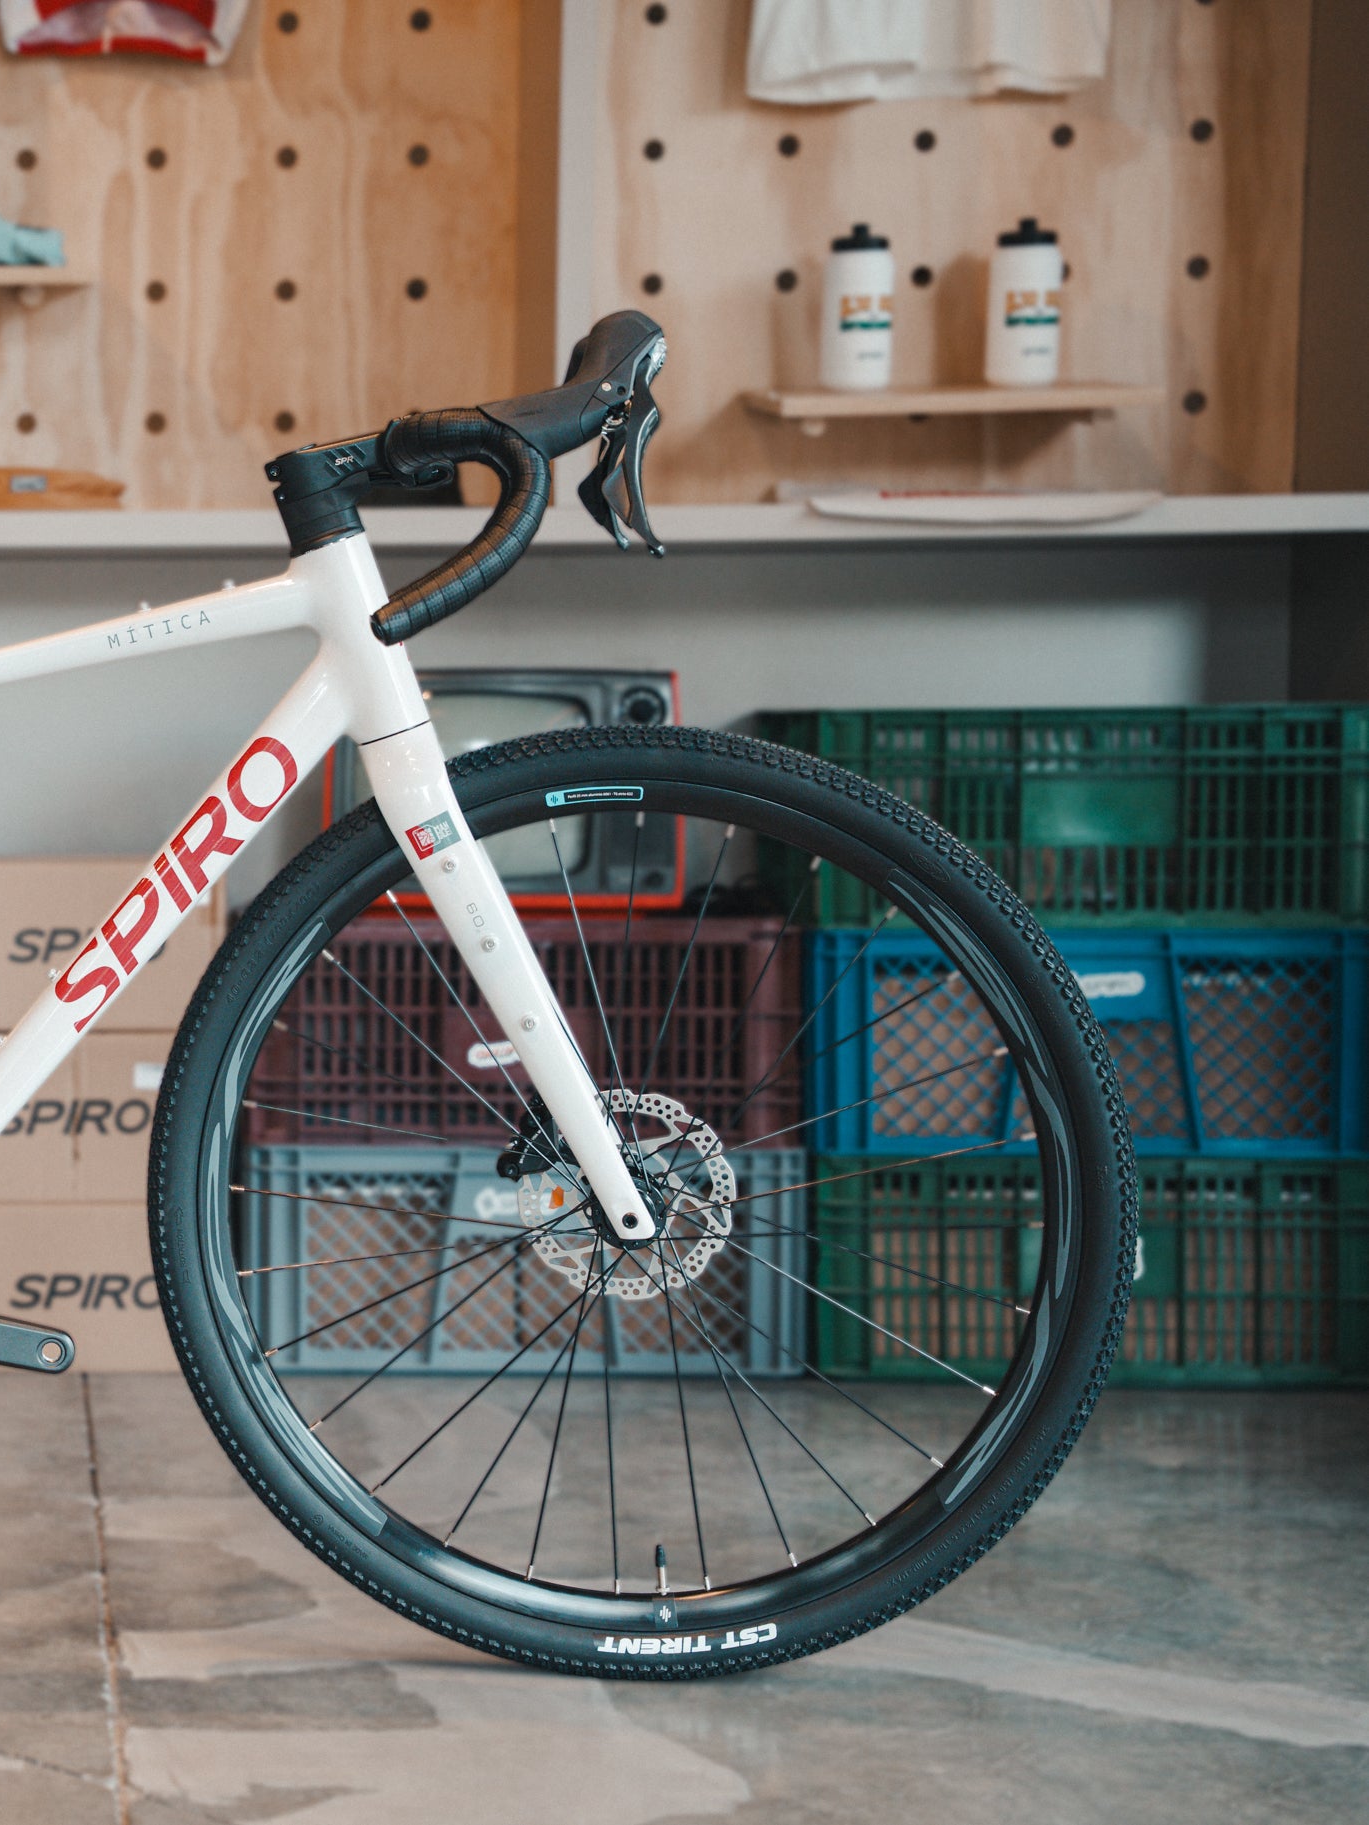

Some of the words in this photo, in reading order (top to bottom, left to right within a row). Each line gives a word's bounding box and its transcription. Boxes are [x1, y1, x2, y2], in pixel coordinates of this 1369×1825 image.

[335, 455, 354, 466] SPR
[107, 610, 211, 649] MÍTICA
[54, 736, 298, 1033] SPIRO
[9, 1274, 161, 1310] SPIRO
[597, 1635, 712, 1655] TIRENT
[720, 1622, 778, 1650] CST
